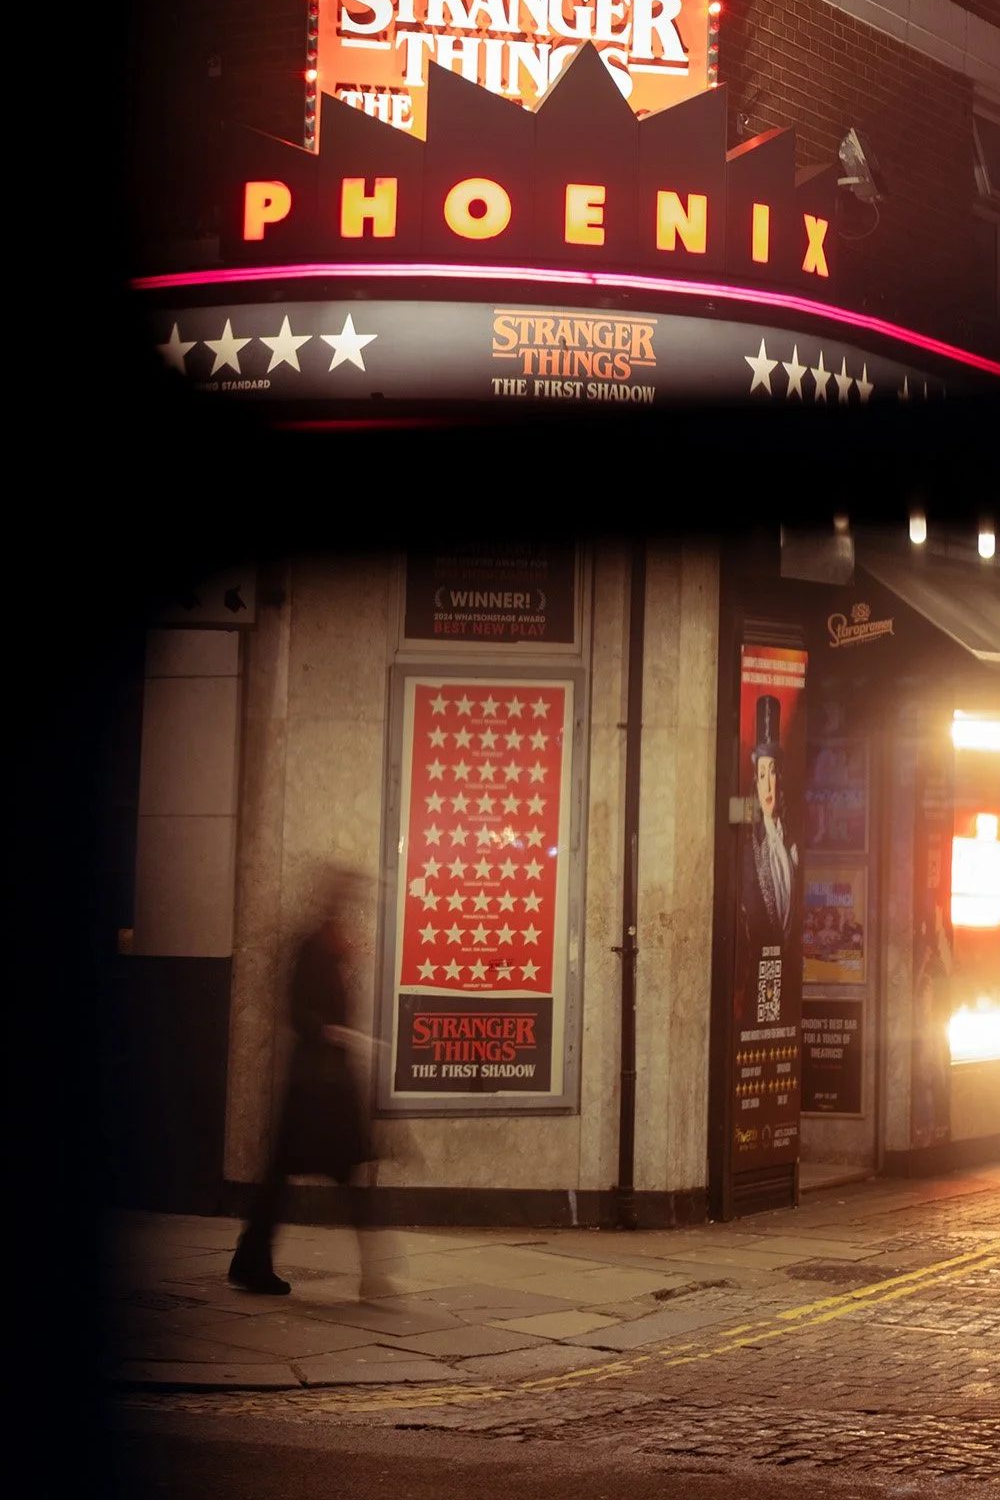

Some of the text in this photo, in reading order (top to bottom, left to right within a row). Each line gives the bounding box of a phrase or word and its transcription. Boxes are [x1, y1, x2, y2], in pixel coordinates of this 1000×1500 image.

[243, 176, 830, 278] PHOENIX
[492, 315, 657, 360] STRANGER
[519, 347, 632, 381] THINGS
[221, 379, 271, 392] STANDARD
[491, 378, 656, 404] THE FIRST SHADOW
[449, 590, 531, 609] WINNER!
[433, 612, 546, 623] 2024 WHATSONSTAGE AWARD
[433, 621, 546, 636] BEST NEW PLAY
[412, 1016, 537, 1044] STRANGER
[431, 1040, 516, 1062] THINGS
[411, 1064, 537, 1078] THE FIRST SHADOW
